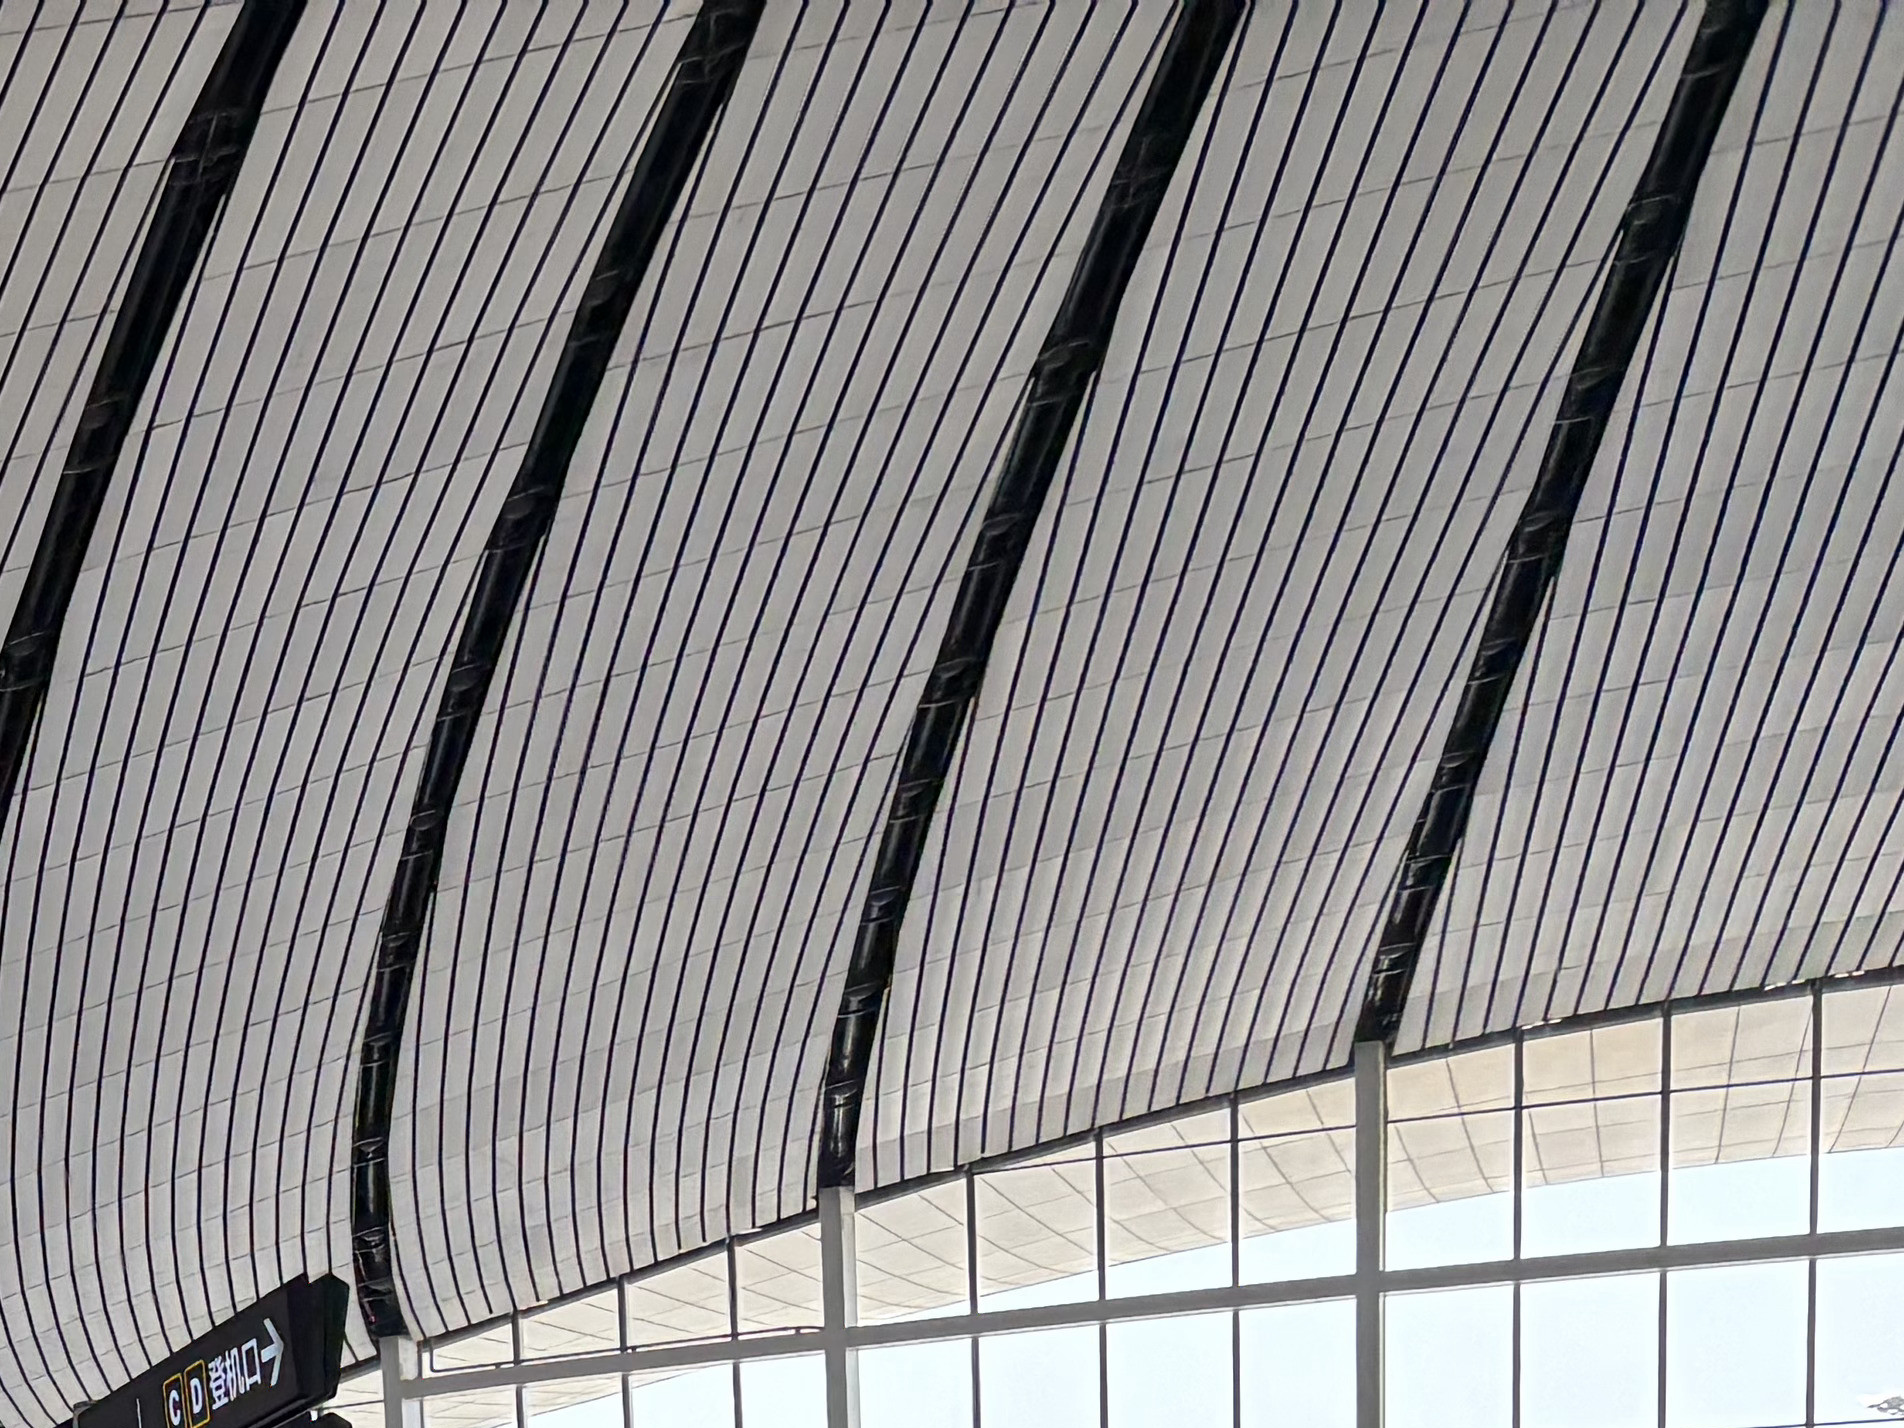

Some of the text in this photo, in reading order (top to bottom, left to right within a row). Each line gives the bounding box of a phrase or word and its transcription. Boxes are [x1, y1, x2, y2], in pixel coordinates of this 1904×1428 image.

[168, 1337, 262, 1426] C D 登机口
